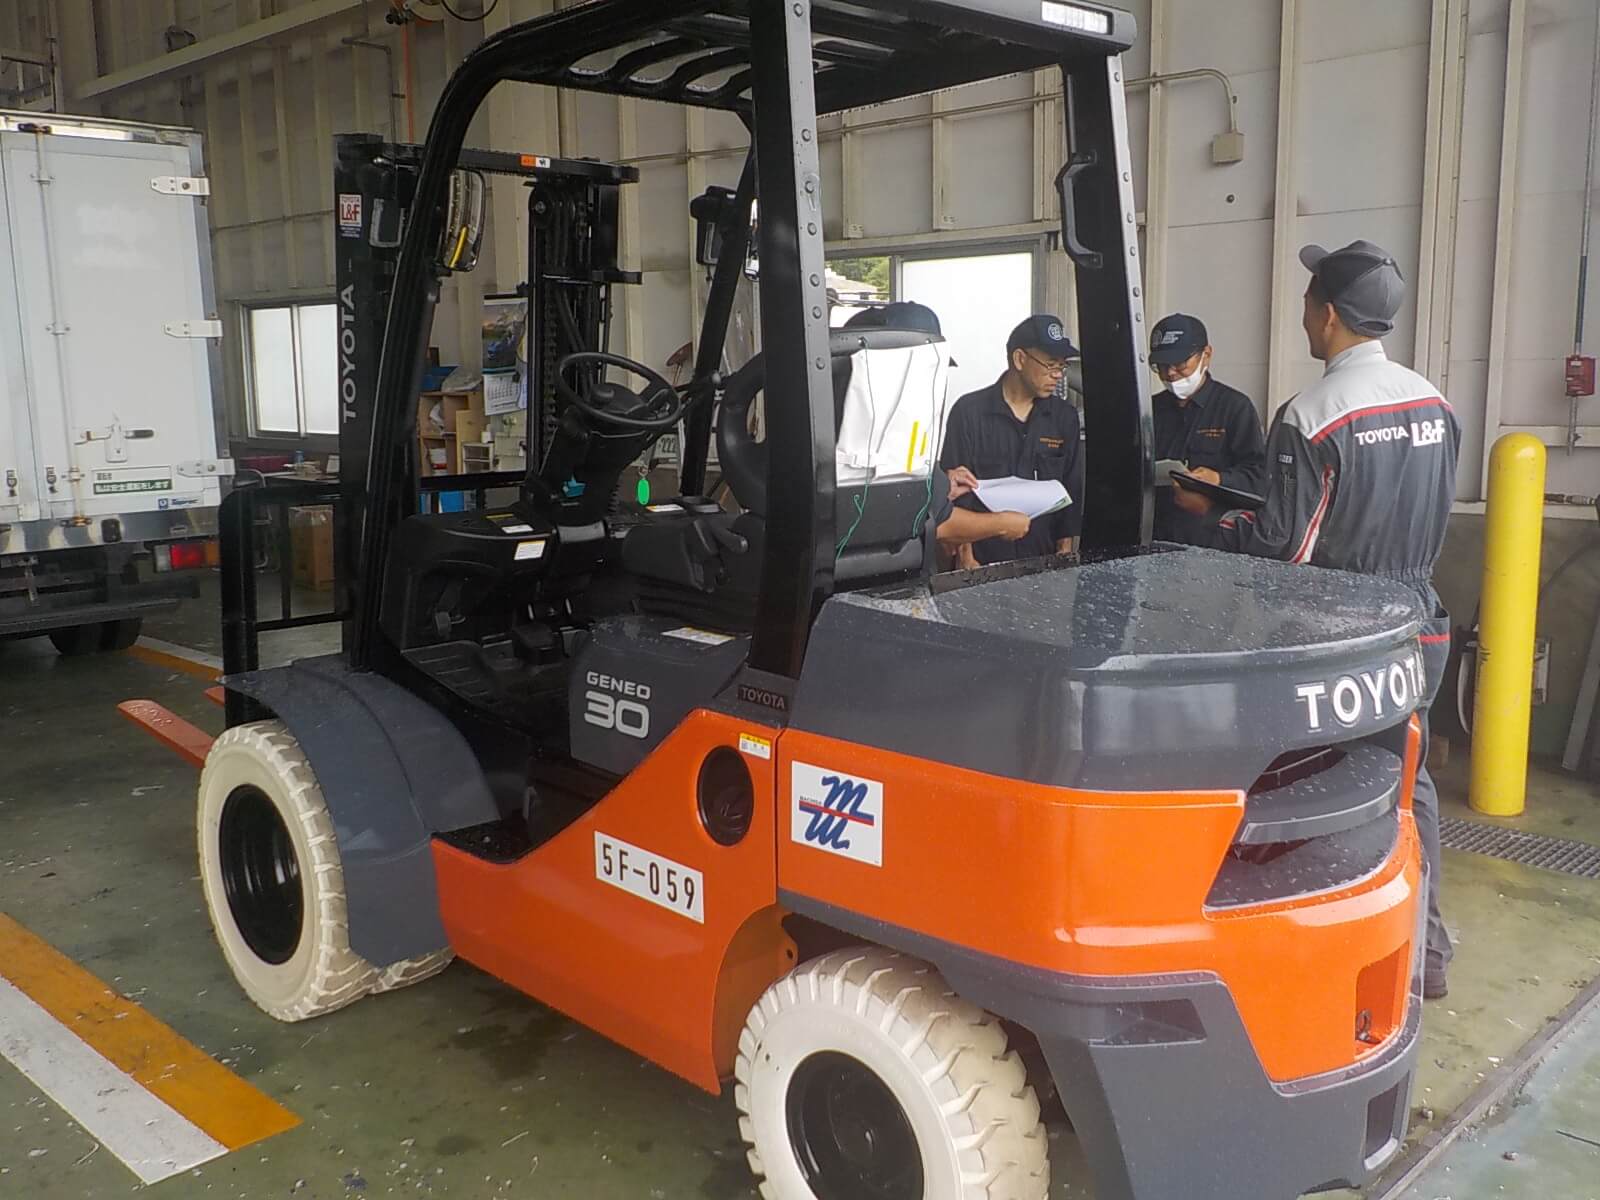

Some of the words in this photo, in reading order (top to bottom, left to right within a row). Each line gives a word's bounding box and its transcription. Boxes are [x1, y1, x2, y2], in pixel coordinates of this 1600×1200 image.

[341, 203, 361, 221] L&F
[340, 284, 357, 424] TOYOTA
[1354, 426, 1409, 446] TOYOTA
[1410, 418, 1446, 447] L&F
[586, 671, 651, 700] GENEO
[741, 686, 786, 710] TOYOTA
[584, 690, 650, 739] 30
[602, 842, 695, 910] 5F-059
